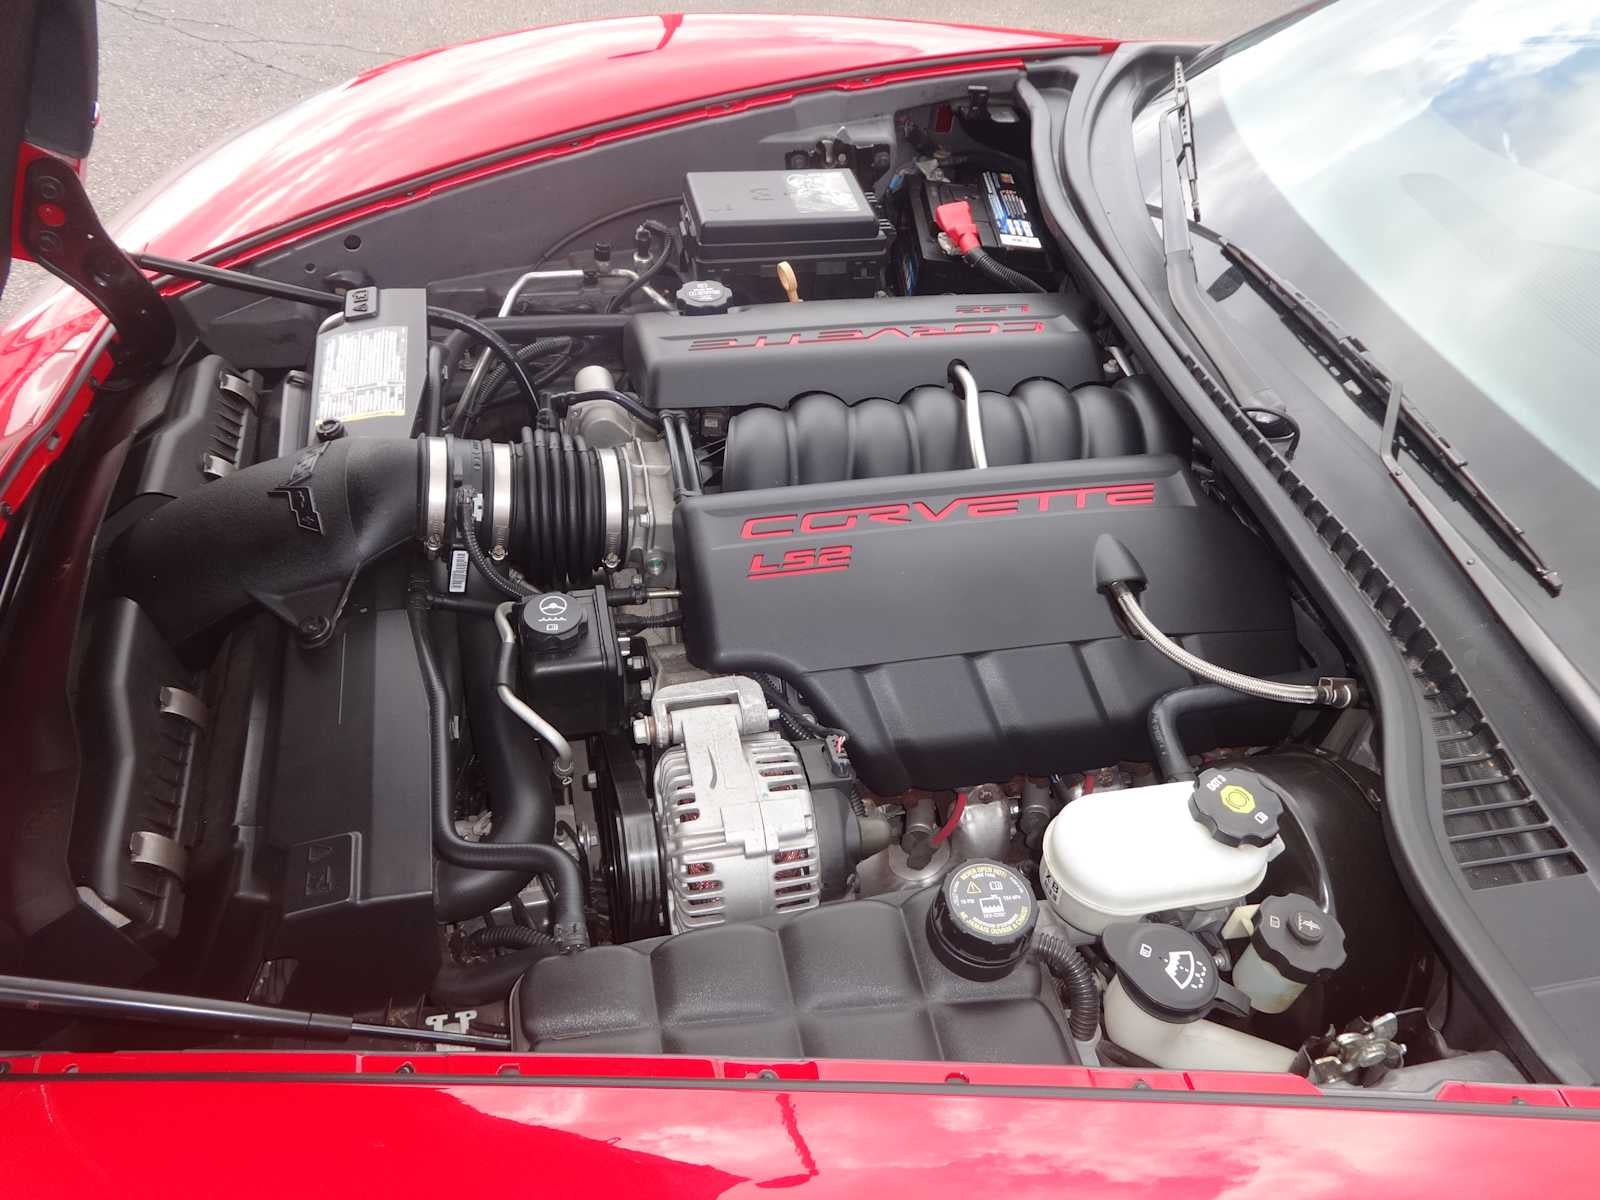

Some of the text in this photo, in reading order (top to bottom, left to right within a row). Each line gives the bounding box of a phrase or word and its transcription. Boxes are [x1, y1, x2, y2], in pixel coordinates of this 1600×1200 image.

[954, 303, 1031, 313] LS2
[687, 320, 1045, 351] CORVETTE
[740, 482, 1155, 540] CORVETTE
[748, 544, 853, 574] LS2
[1206, 776, 1222, 791] DOT
